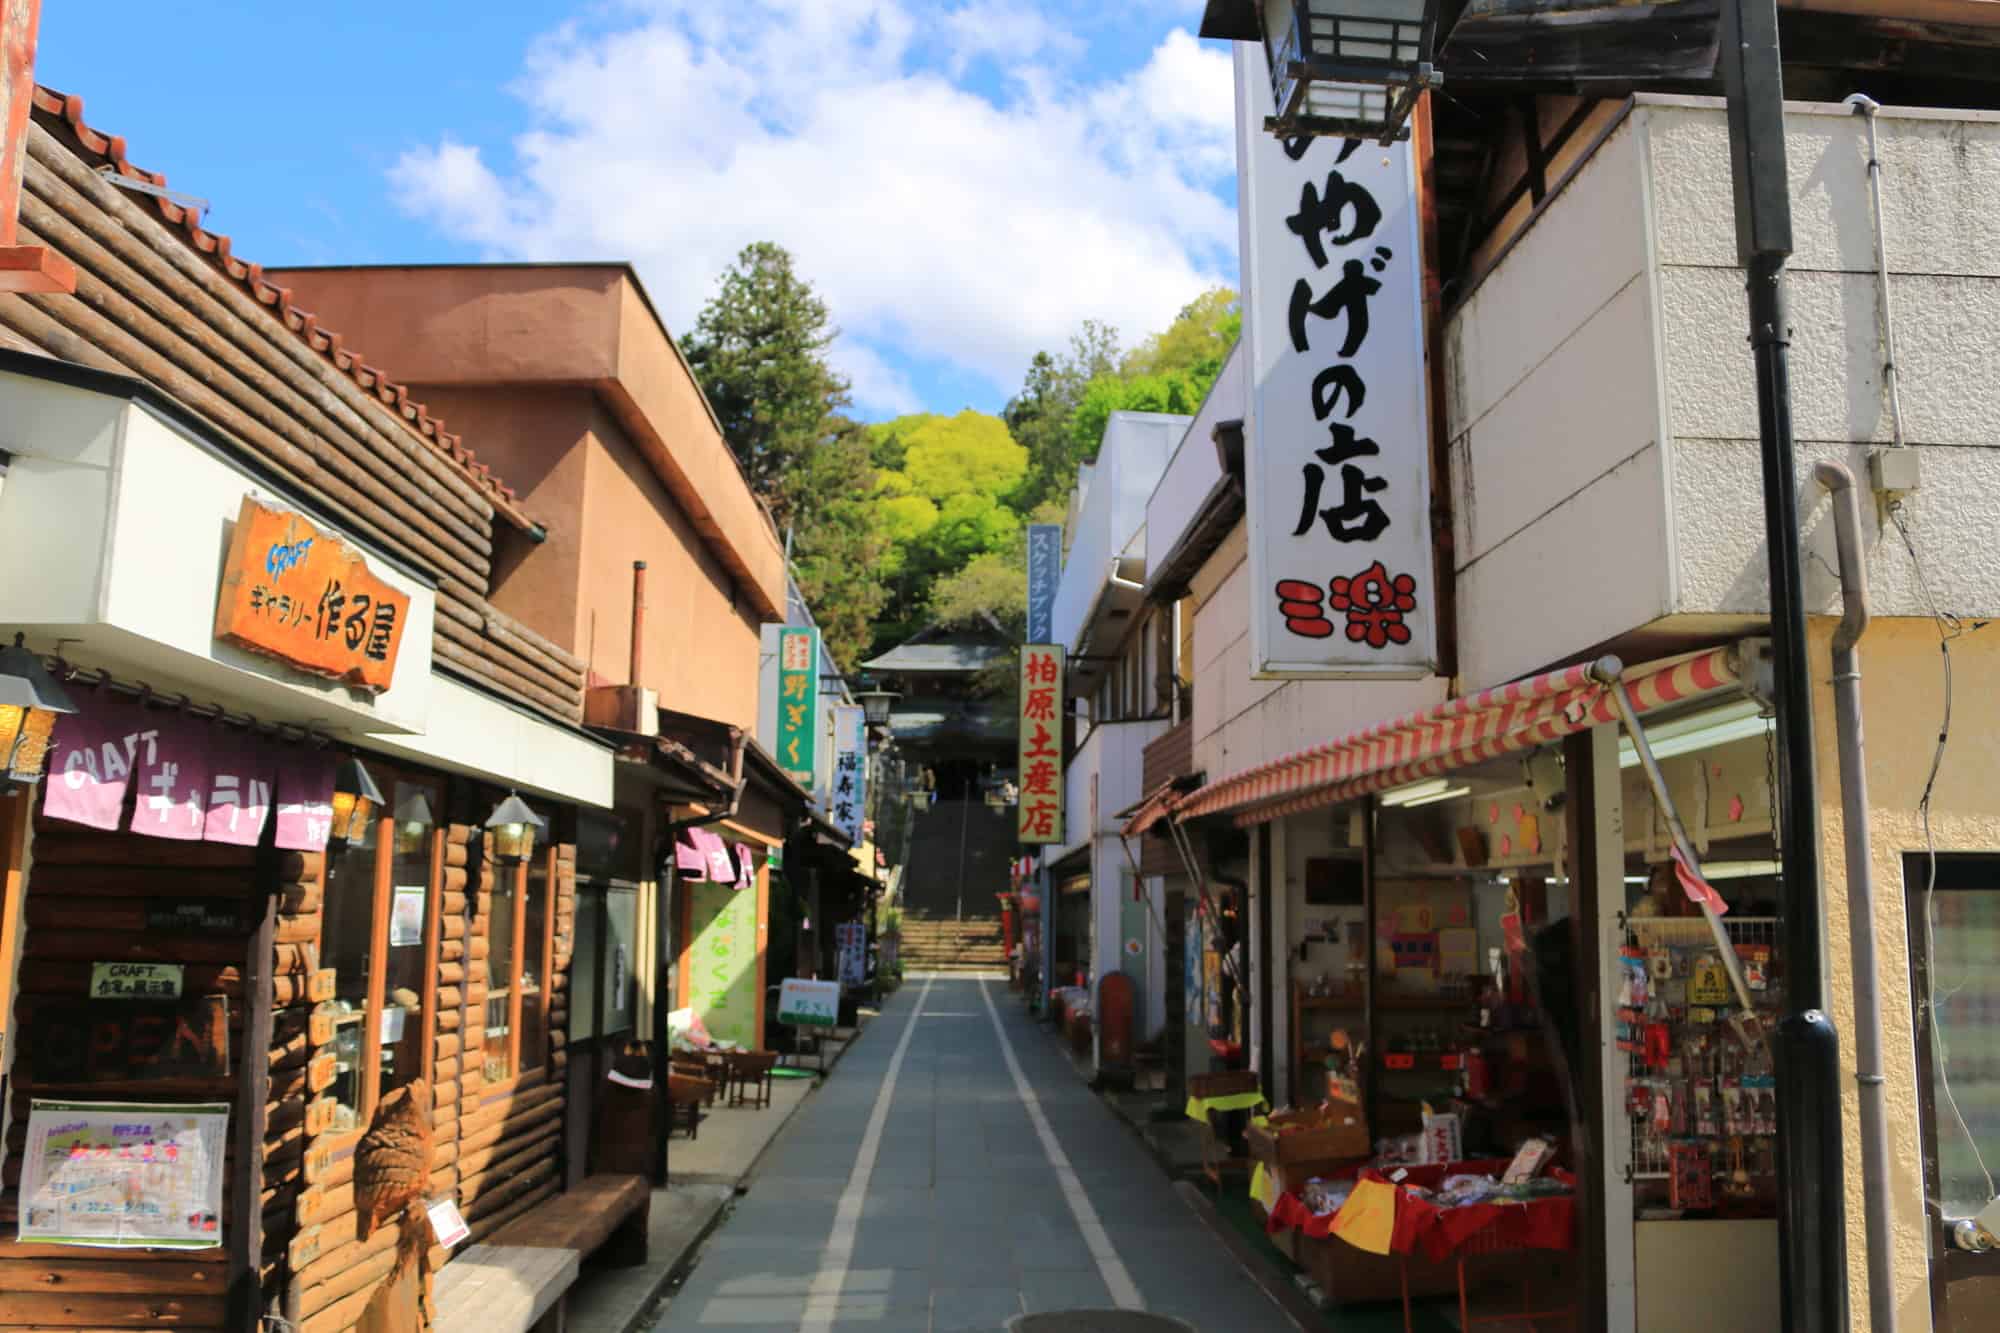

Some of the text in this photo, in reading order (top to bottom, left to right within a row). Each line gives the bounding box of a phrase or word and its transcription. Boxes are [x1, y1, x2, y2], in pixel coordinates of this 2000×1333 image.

[265, 538, 313, 583] CRAFT
[783, 674, 809, 765] 野ぎく
[1022, 651, 1060, 837] 柏原土産店
[64, 729, 160, 790] CRAFT
[110, 965, 156, 977] CRAFT
